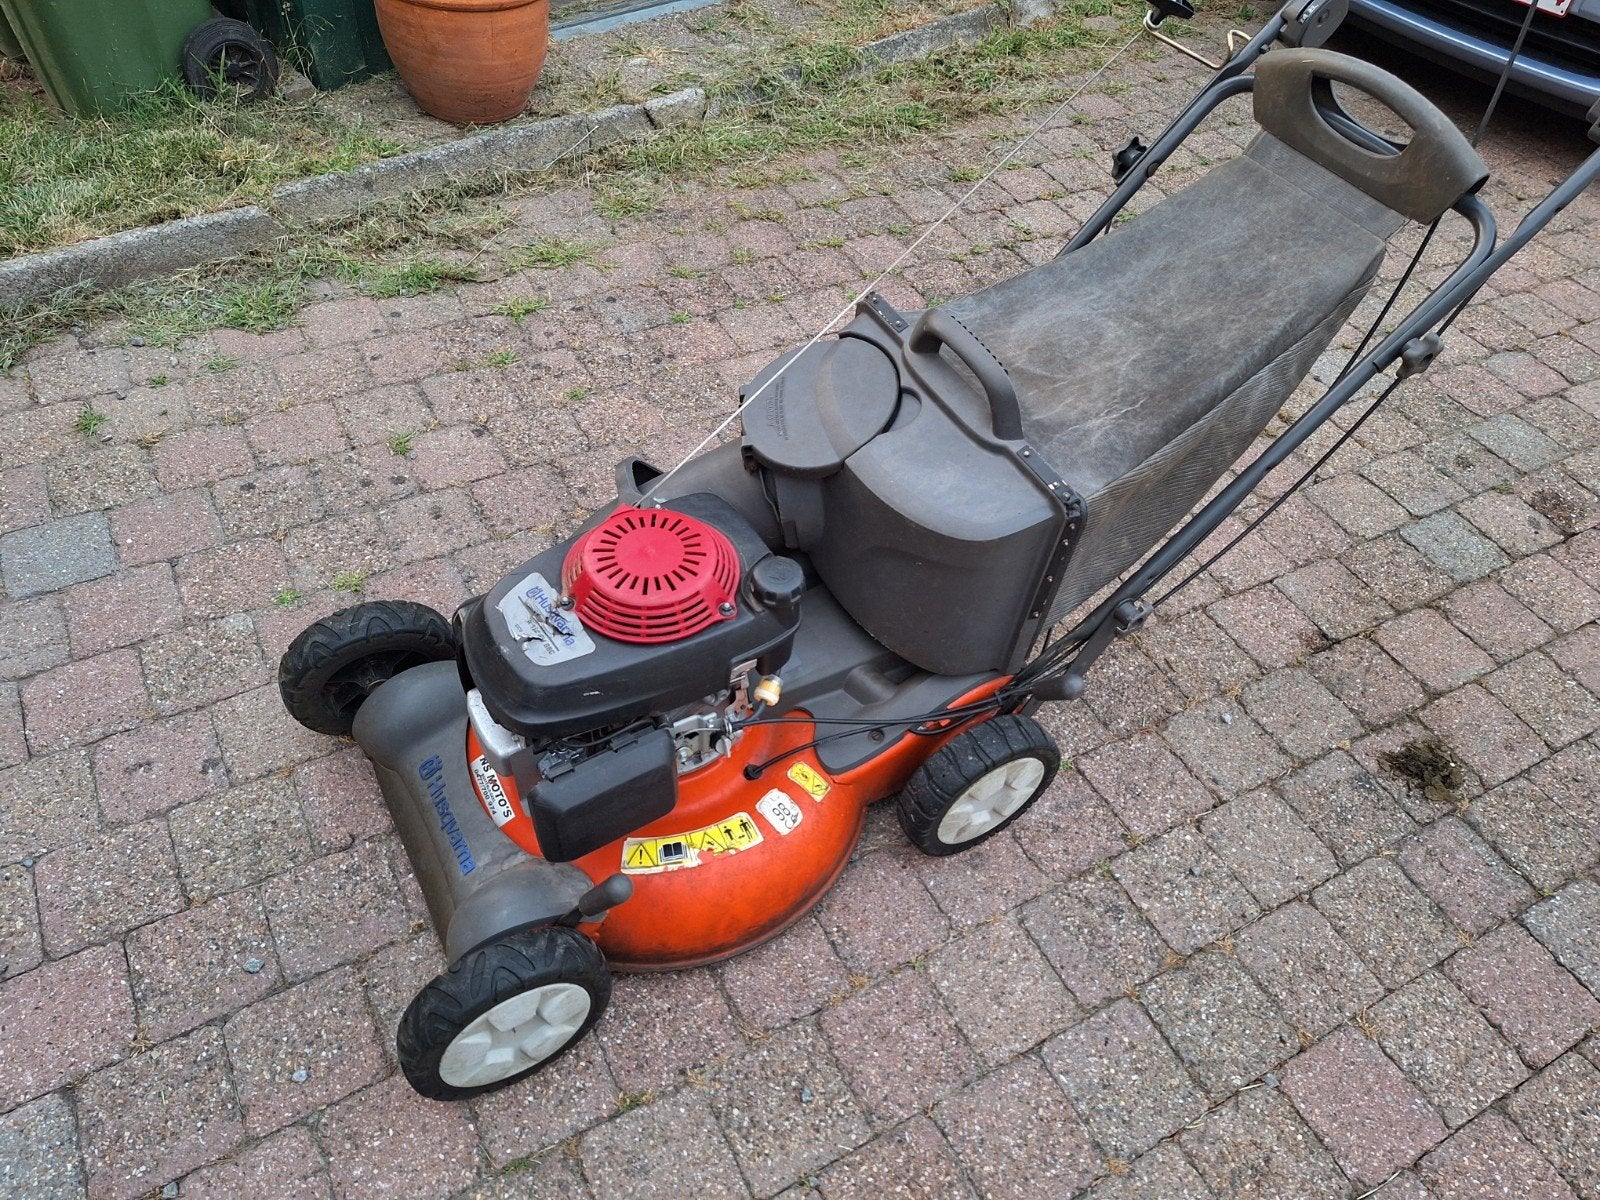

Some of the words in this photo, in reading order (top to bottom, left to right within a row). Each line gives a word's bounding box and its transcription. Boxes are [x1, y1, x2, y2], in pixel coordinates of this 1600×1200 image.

[480, 757, 491, 772] NS
[487, 774, 512, 817] MOTO'S
[772, 802, 791, 821] 98
[427, 775, 477, 876] Husqvarna
